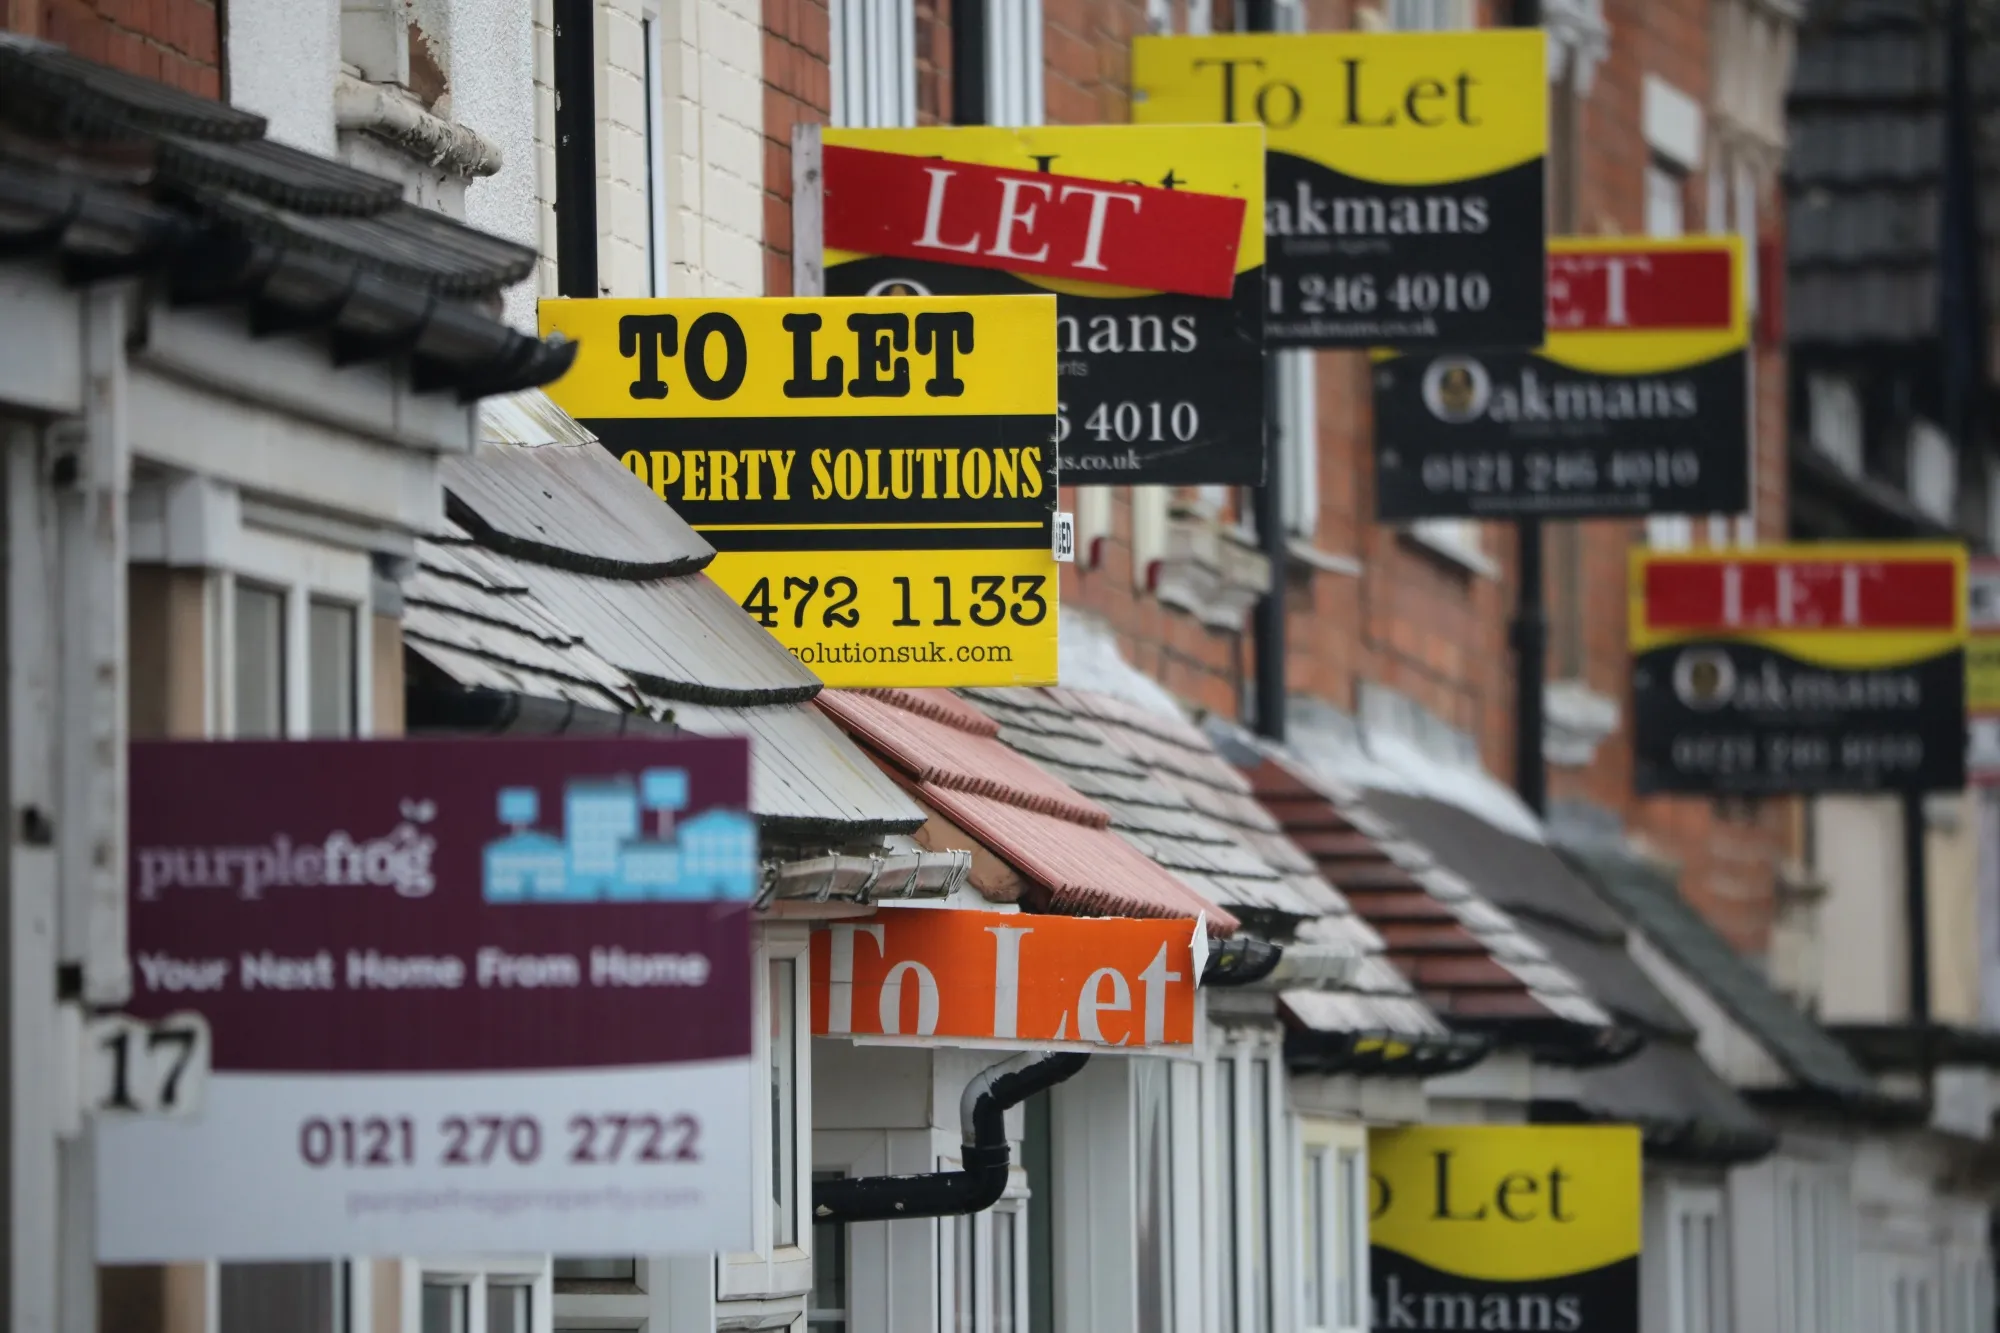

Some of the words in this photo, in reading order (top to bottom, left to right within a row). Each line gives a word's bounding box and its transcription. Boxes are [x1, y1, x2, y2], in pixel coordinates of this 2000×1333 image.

[1193, 57, 1303, 129] To
[1340, 57, 1482, 128] Let
[912, 167, 1142, 271] LET
[1298, 274, 1378, 313] 246
[1386, 273, 1491, 311] 4010
[618, 312, 747, 401] TO
[782, 312, 975, 398] LET
[1422, 354, 1697, 424] Oakmans
[1085, 402, 1199, 442] 4010
[811, 446, 1043, 499] SOLUTIONS
[741, 576, 860, 628] 472
[892, 575, 1047, 627] 1133
[139, 951, 228, 991] Your
[240, 952, 334, 990] Next
[346, 950, 464, 989] Home
[477, 948, 577, 987] From
[591, 946, 709, 987] Home
[825, 924, 939, 1036] To
[984, 927, 1181, 1048] Let
[101, 1028, 197, 1111] 17
[300, 1115, 416, 1168] 0121
[440, 1114, 542, 1166] 270
[567, 1112, 703, 1166] 2722
[1430, 1149, 1576, 1222] Let
